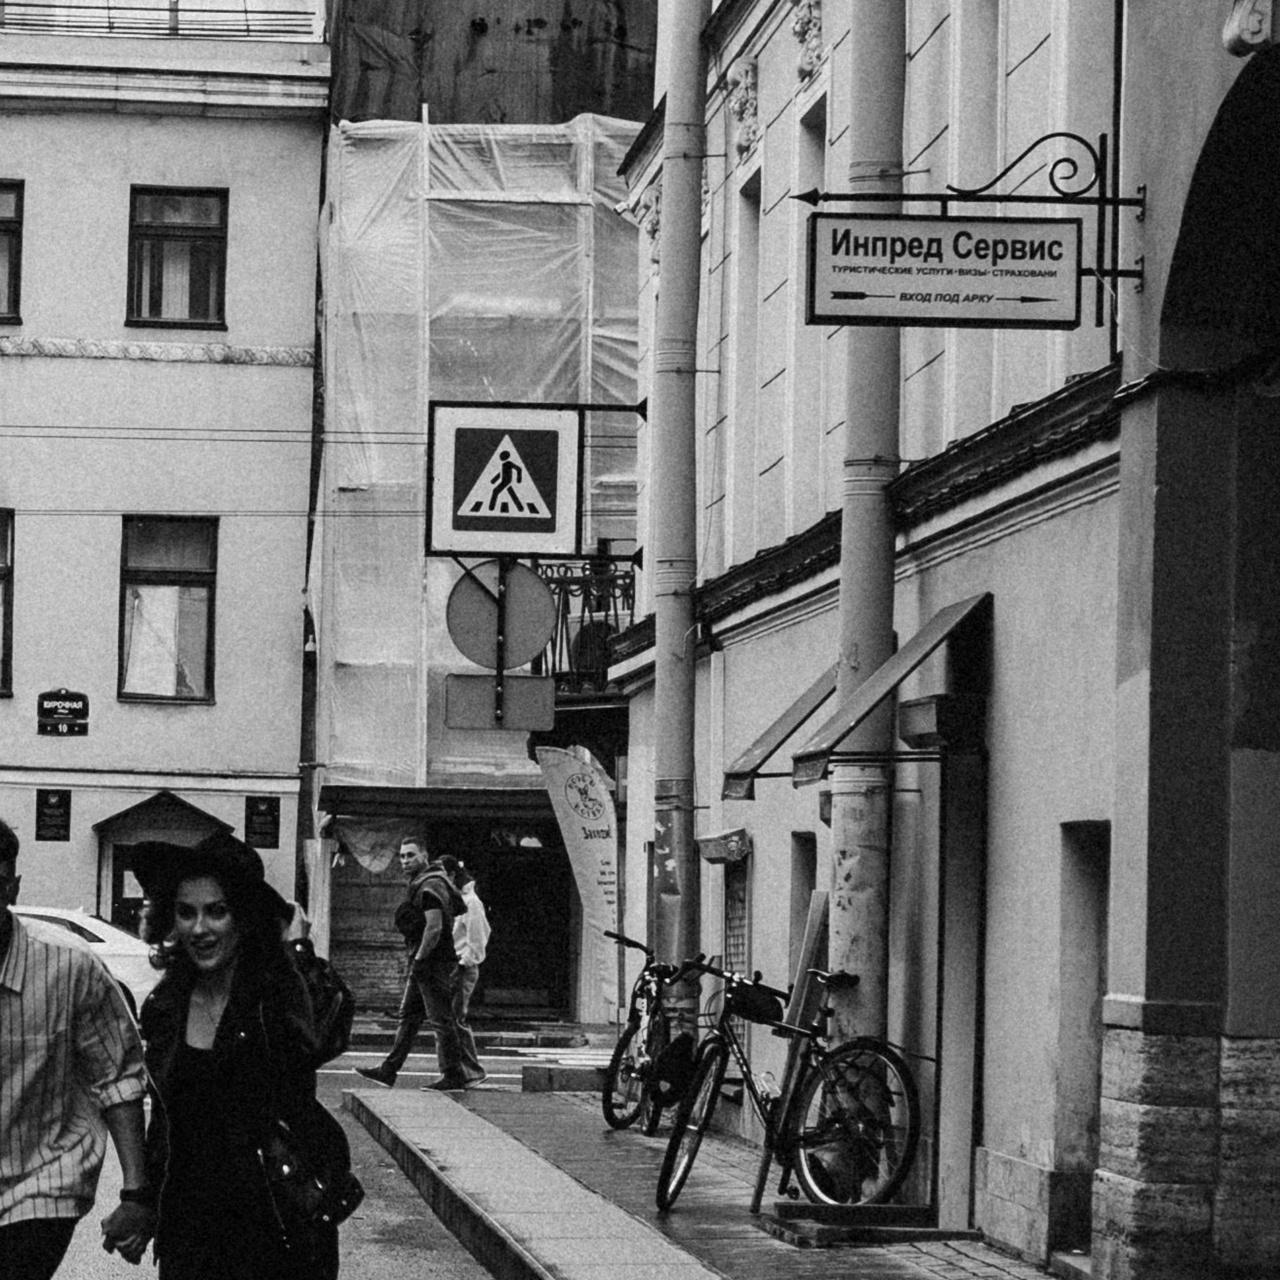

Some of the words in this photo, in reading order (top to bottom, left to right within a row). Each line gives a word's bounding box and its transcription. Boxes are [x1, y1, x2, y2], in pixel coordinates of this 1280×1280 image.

[831, 227, 944, 265] Инпред
[952, 230, 1064, 267] Сервис
[831, 265, 914, 276] ТУРИСТИЧЕСКИЕ
[915, 267, 954, 276] УСЛУГИ
[899, 291, 933, 304] ВХОД
[934, 292, 961, 305] ПОД
[961, 293, 995, 304] АРКУ
[58, 723, 68, 733] 10
